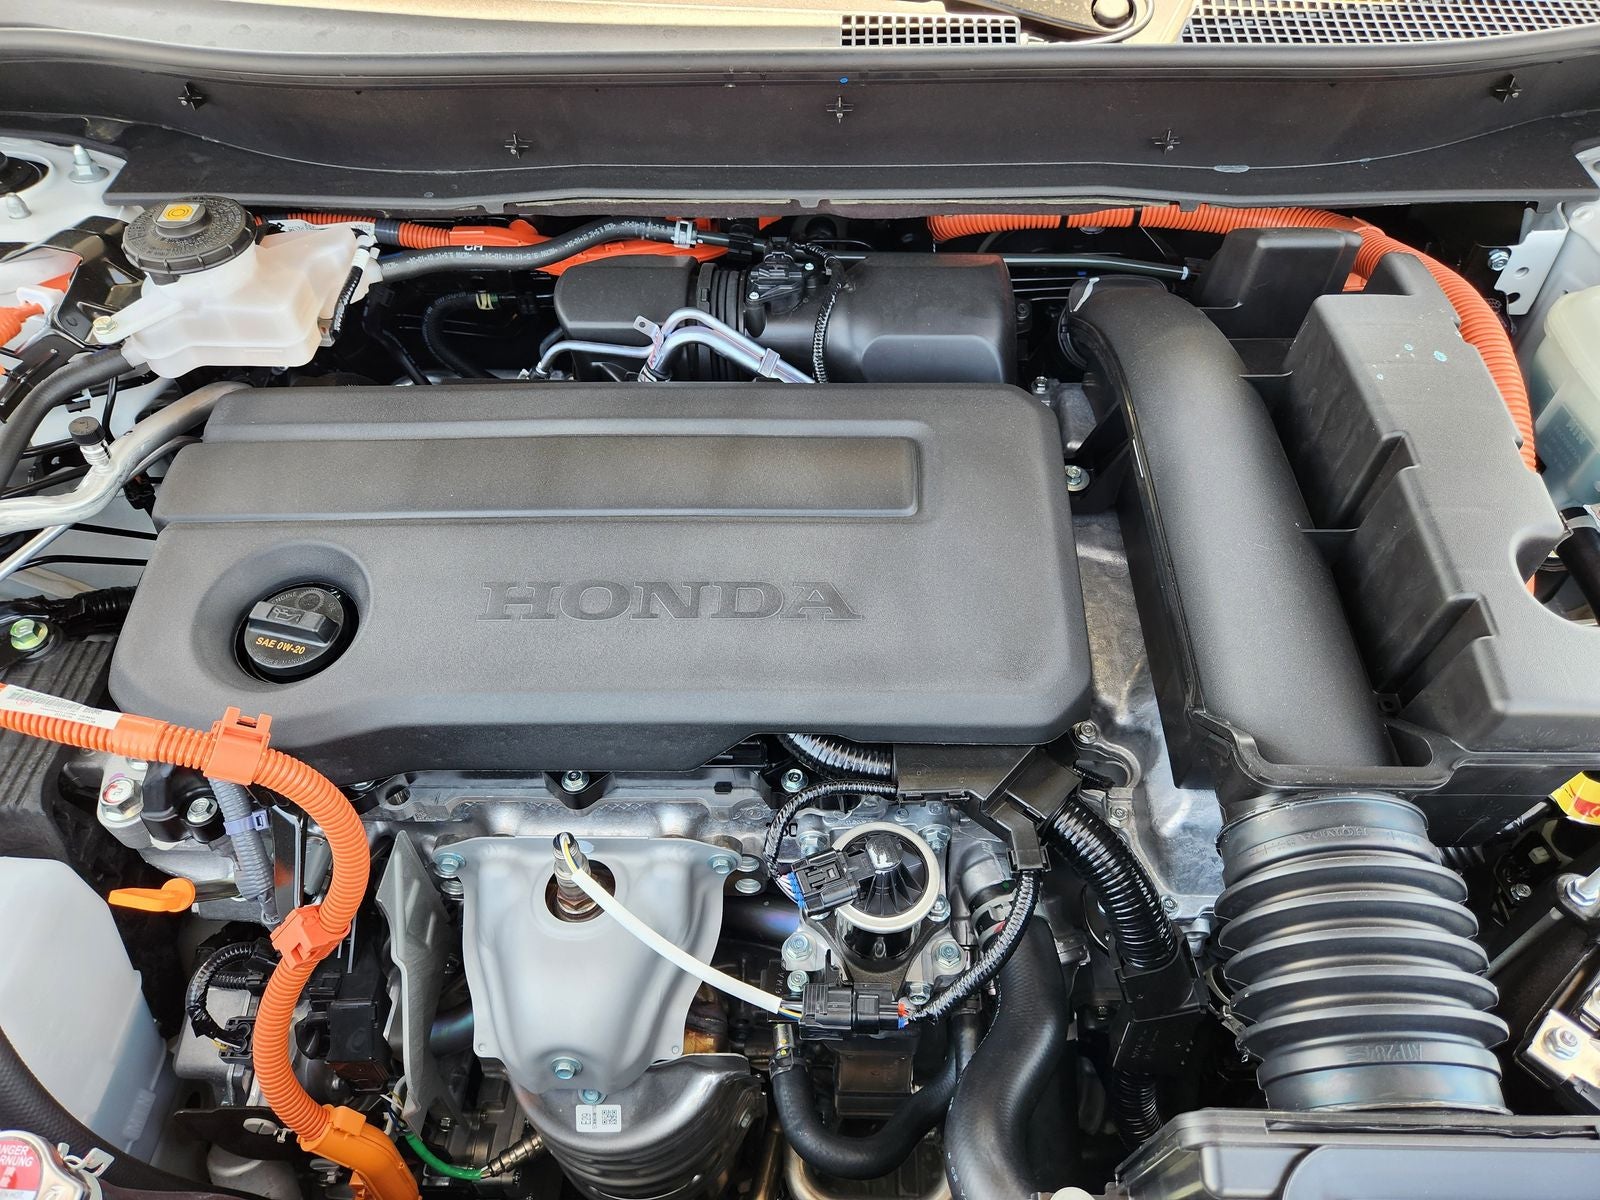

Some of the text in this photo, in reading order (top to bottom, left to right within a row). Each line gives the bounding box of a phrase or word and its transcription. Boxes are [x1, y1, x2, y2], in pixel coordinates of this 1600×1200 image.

[476, 580, 862, 620] HONDA
[256, 637, 305, 654] SAE 0W-20
[0, 1144, 29, 1156] NGER
